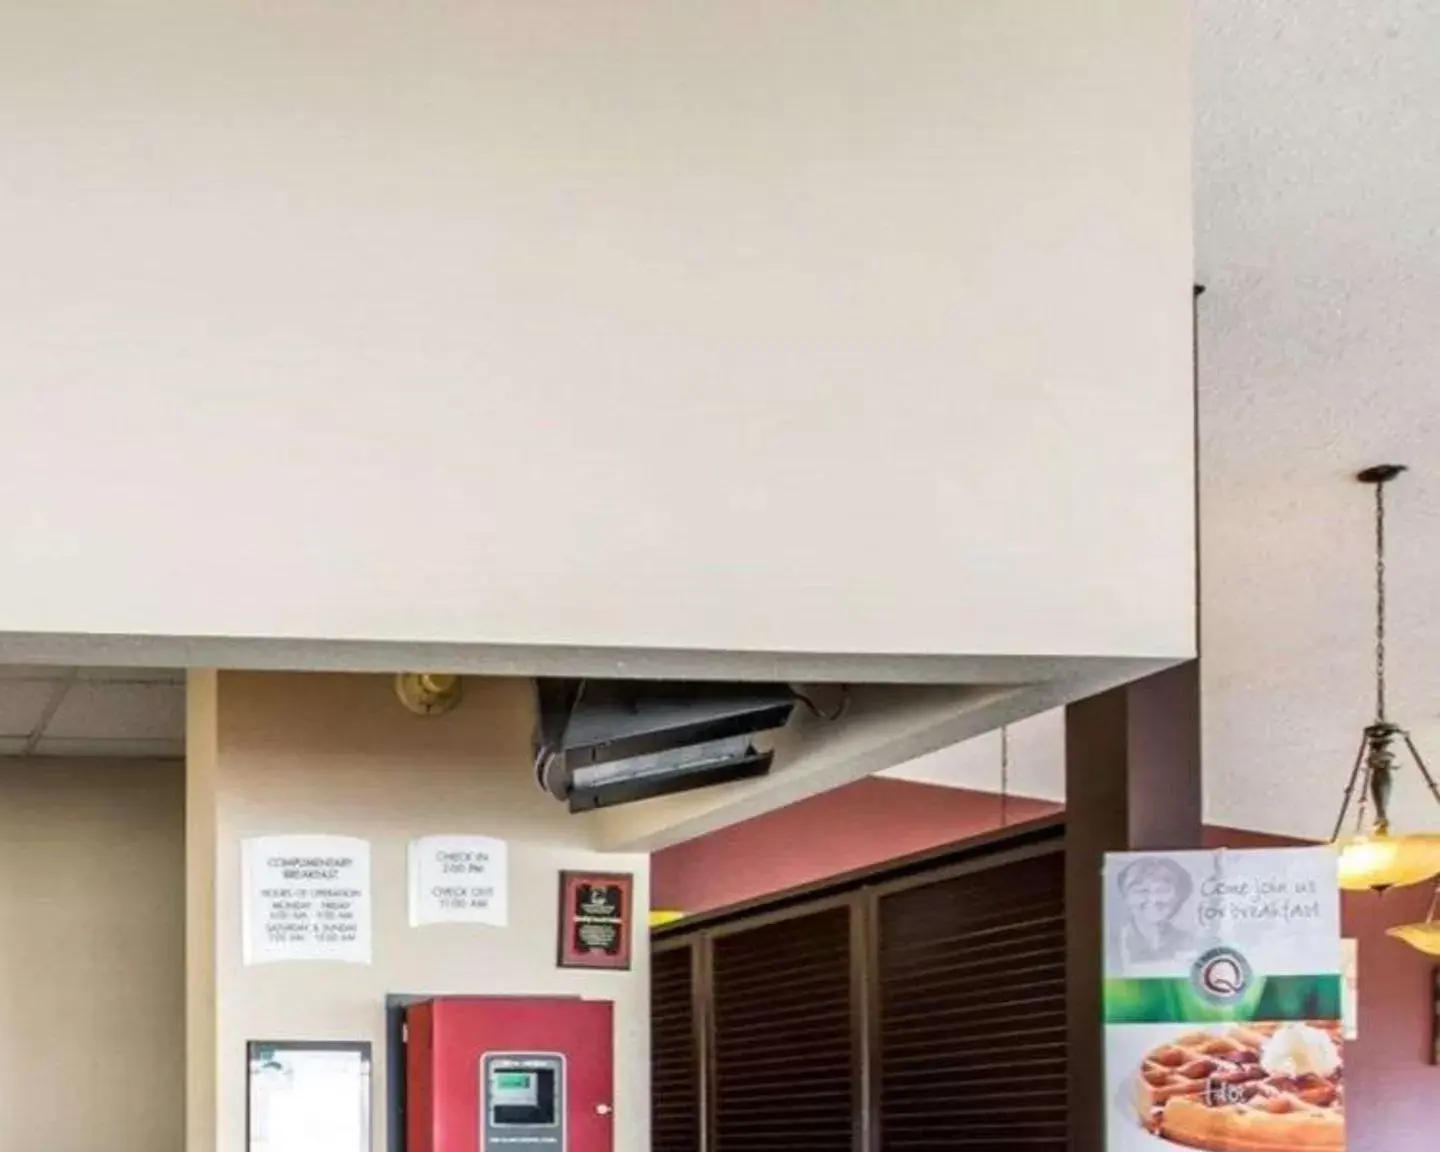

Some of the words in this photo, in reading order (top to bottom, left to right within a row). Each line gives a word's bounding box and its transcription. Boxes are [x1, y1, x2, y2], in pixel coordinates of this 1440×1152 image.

[435, 850, 471, 861] CHECK
[282, 869, 340, 878] BREAKFAST
[431, 886, 467, 897] CHECK
[471, 886, 494, 897] OUT
[1200, 876, 1249, 897] Come
[1197, 900, 1224, 927] for
